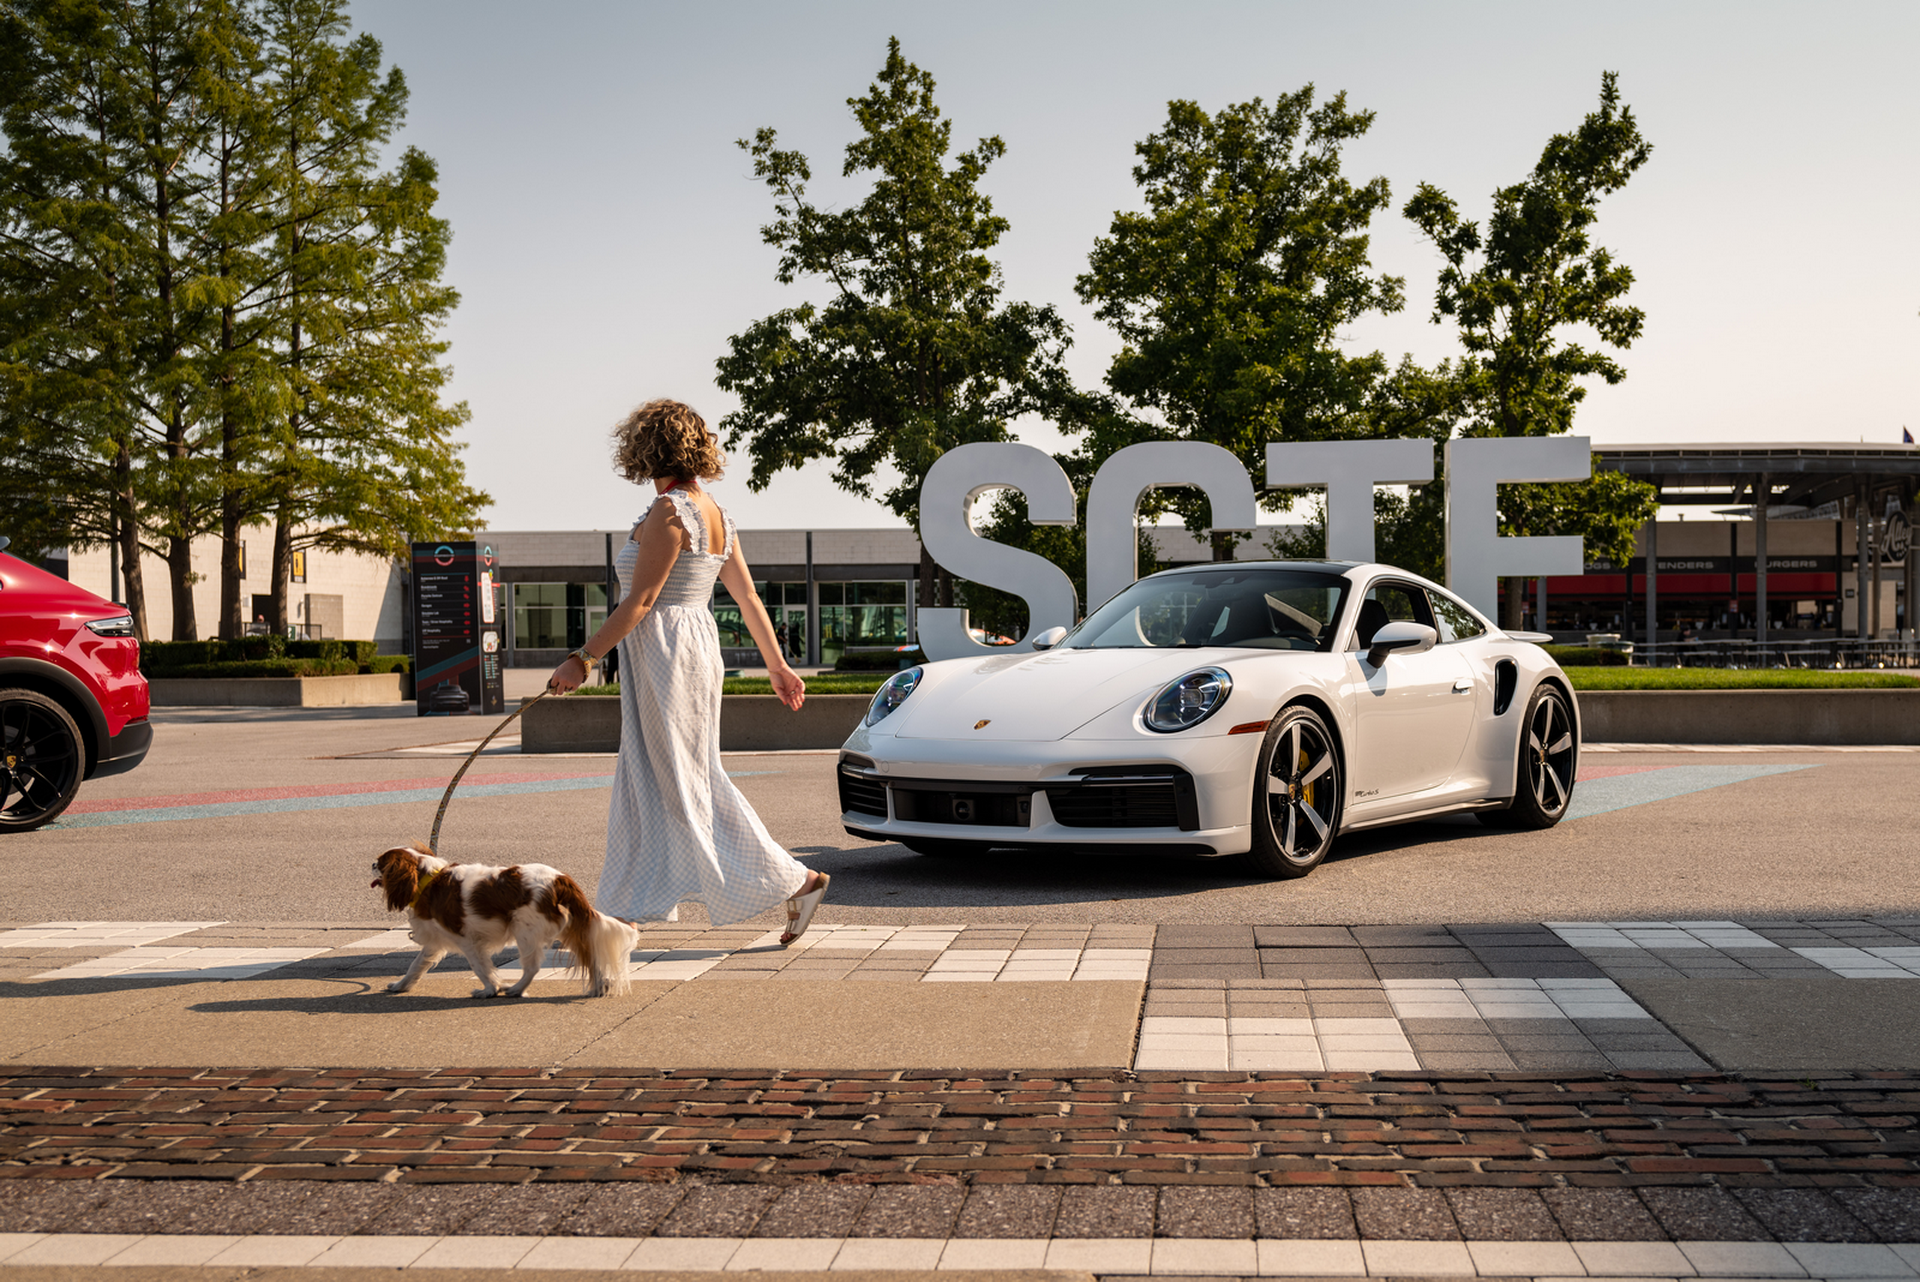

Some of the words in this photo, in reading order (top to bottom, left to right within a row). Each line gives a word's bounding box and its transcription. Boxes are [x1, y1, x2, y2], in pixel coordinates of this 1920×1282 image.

[1882, 514, 1913, 552] Alley
[1583, 562, 1611, 570] OGS
[1656, 561, 1714, 570] ENDERS
